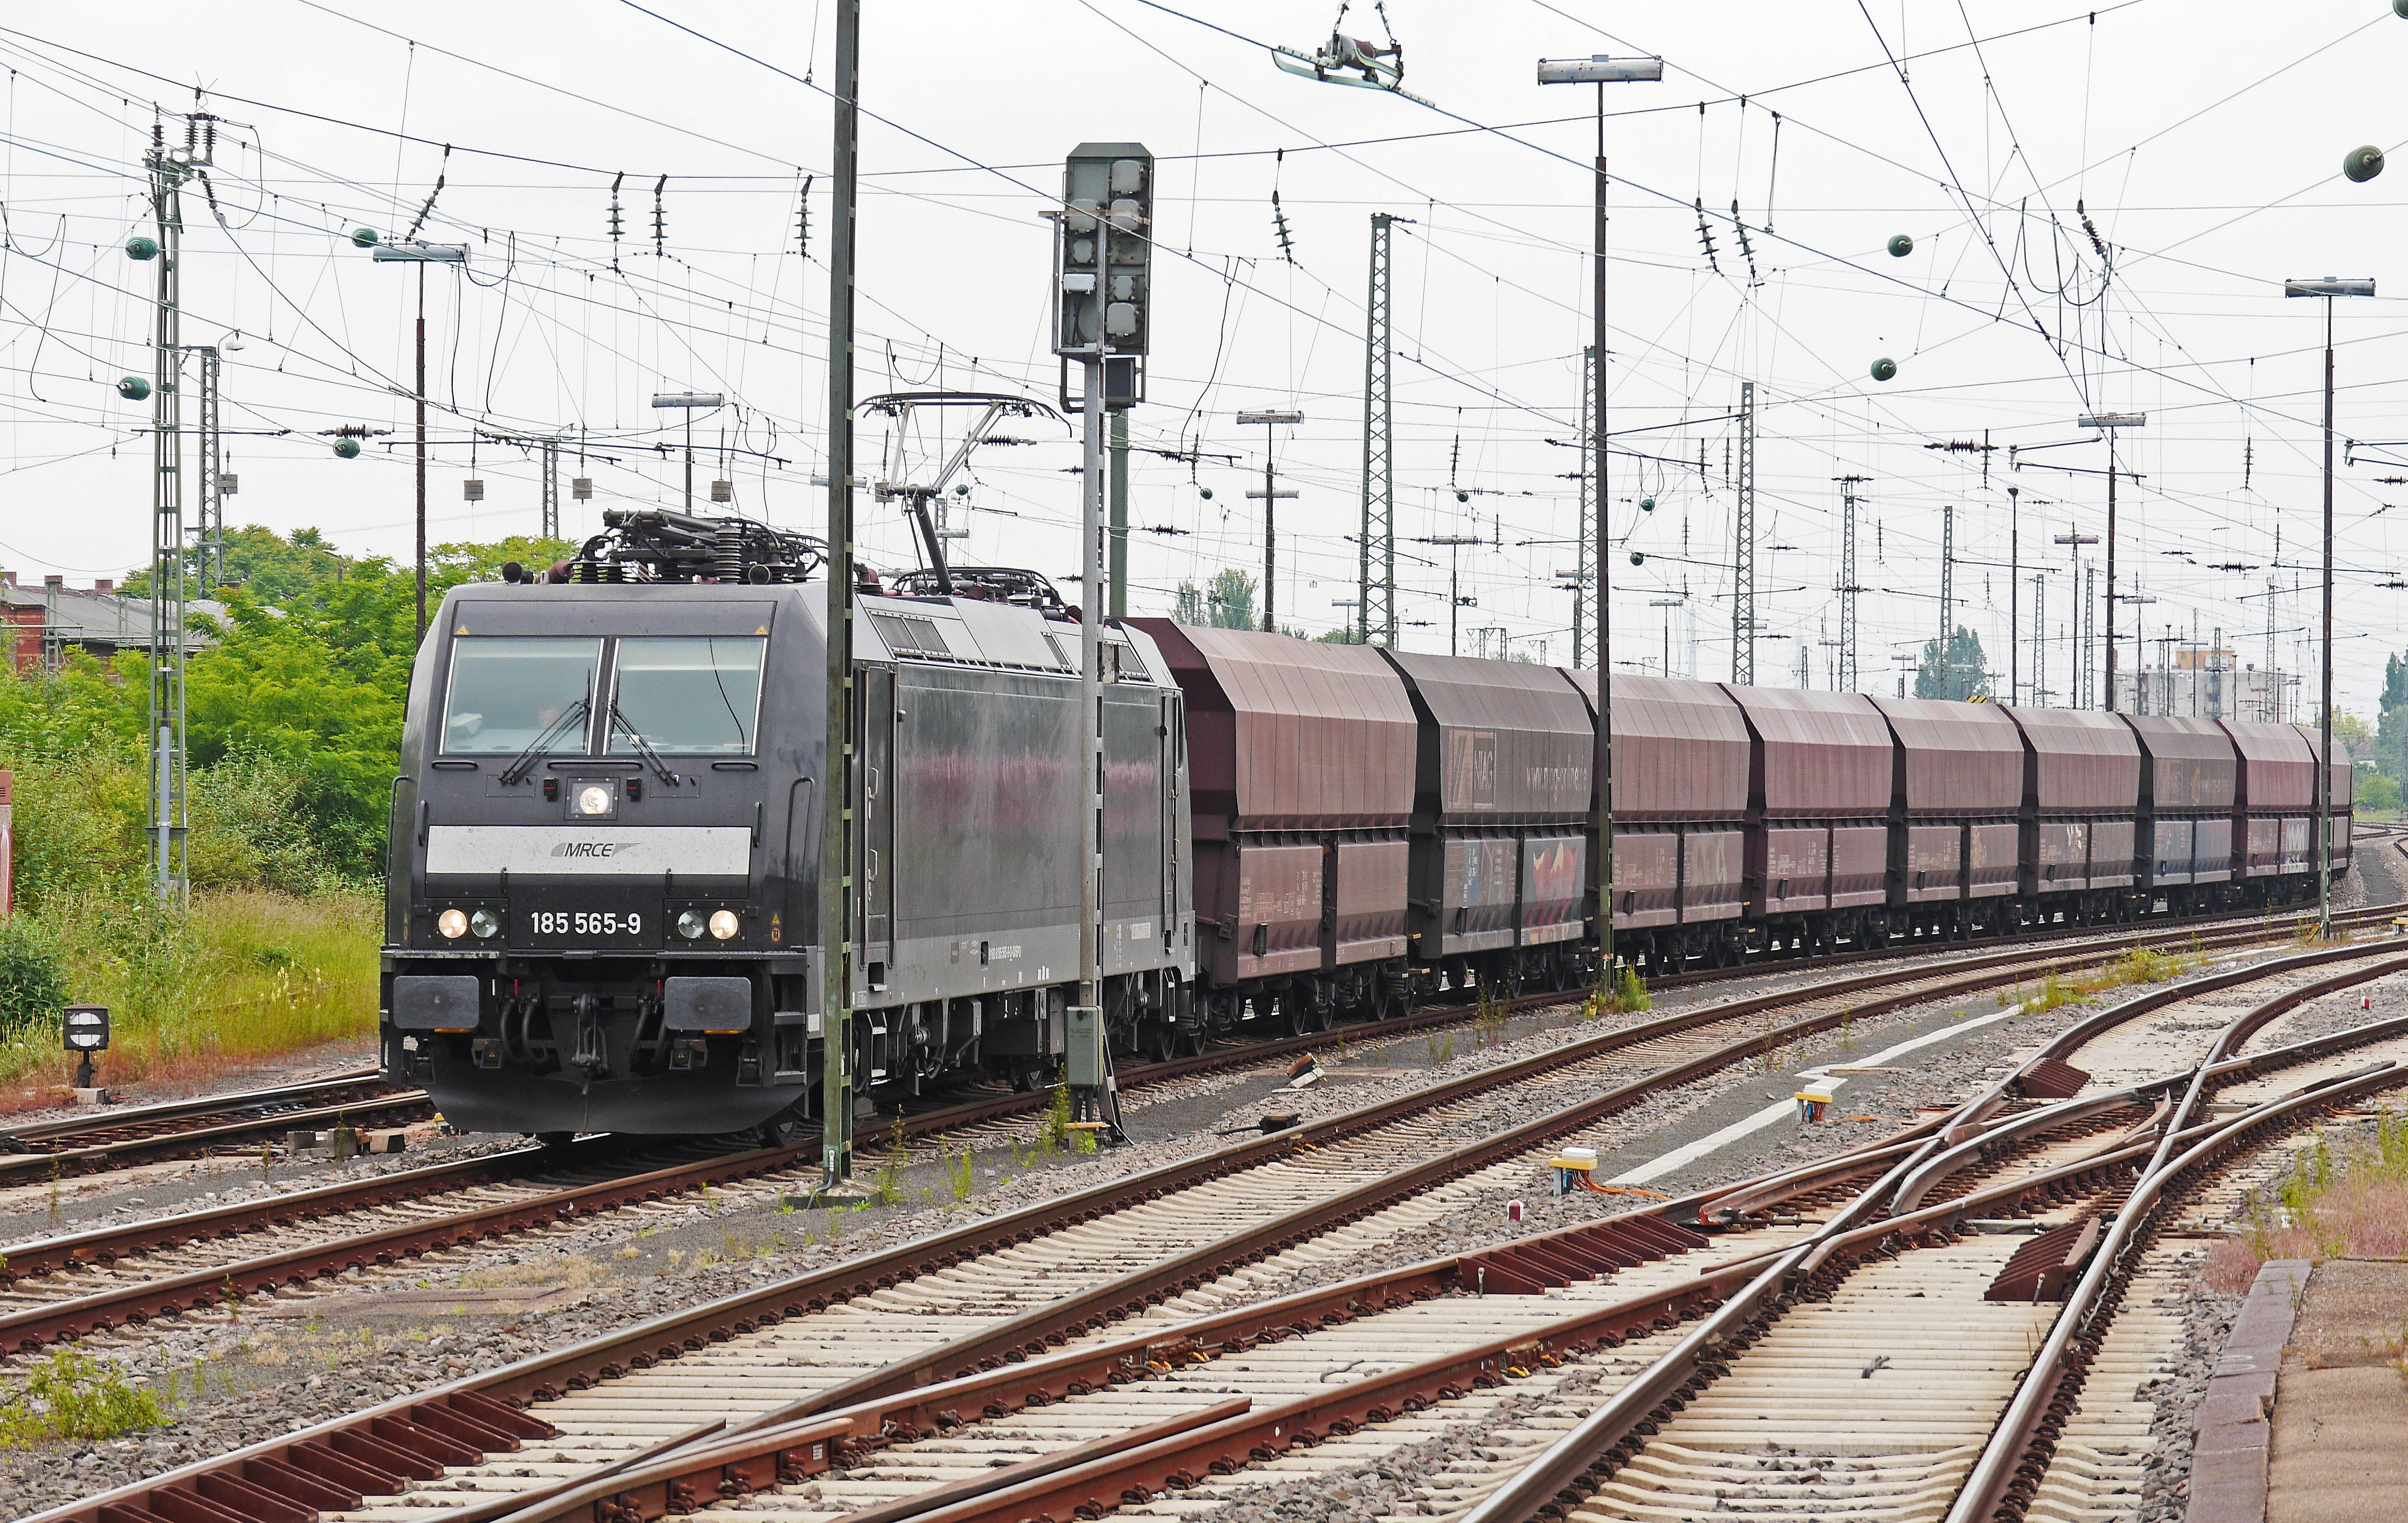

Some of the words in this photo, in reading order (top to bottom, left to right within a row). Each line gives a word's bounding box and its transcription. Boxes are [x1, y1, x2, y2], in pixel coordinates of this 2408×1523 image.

[564, 842, 614, 857] MRCE
[531, 911, 569, 934] 185
[574, 912, 641, 935] 565-9
